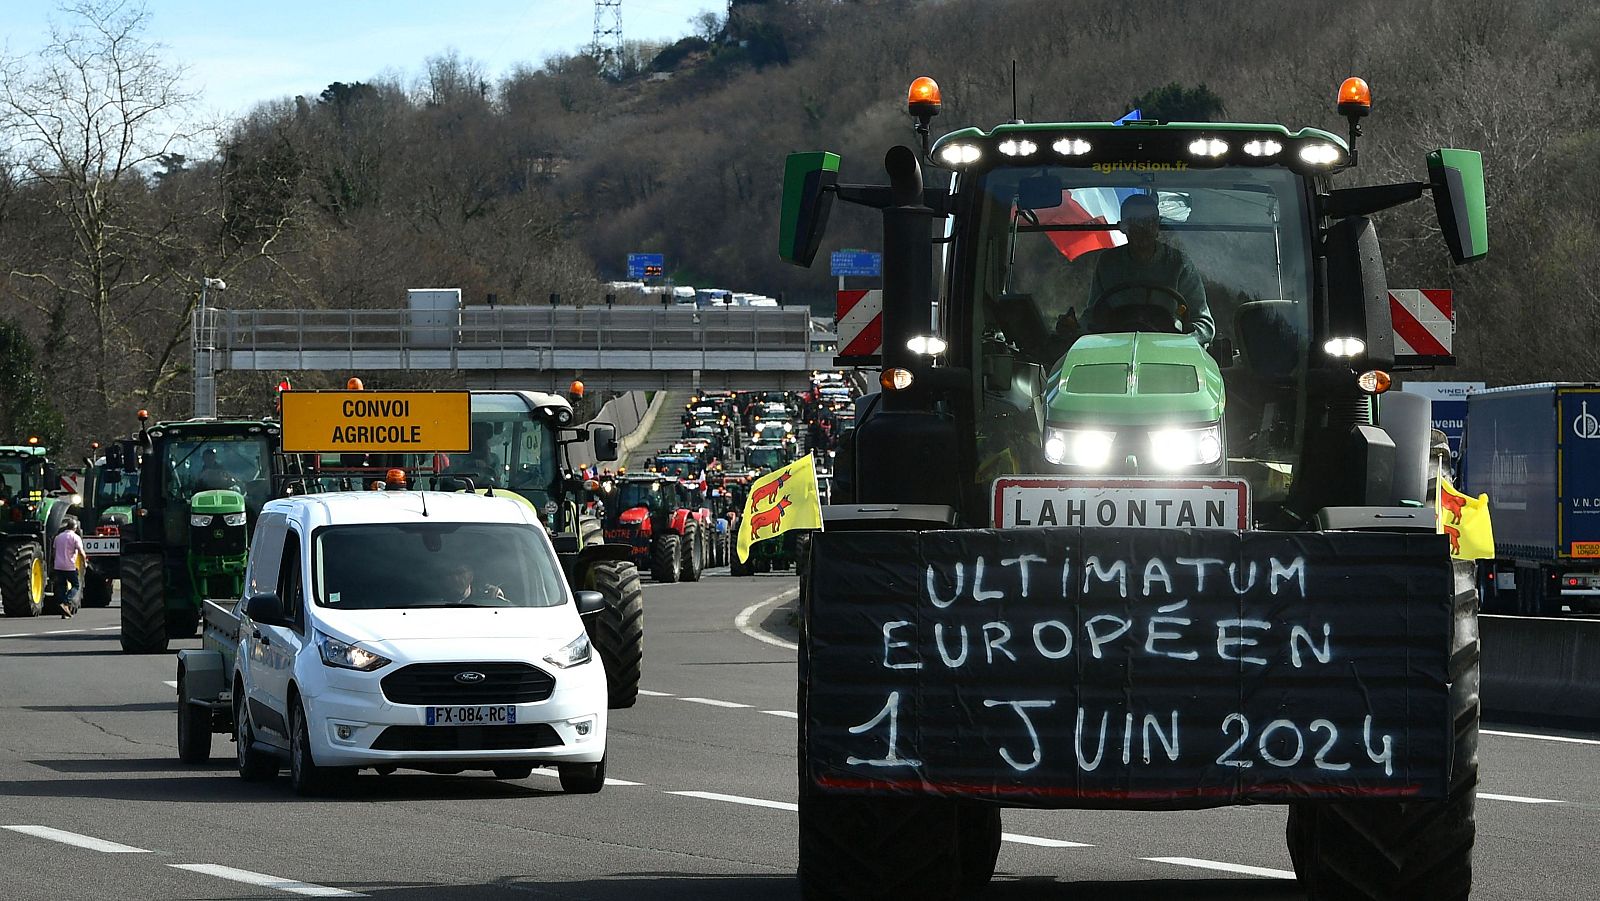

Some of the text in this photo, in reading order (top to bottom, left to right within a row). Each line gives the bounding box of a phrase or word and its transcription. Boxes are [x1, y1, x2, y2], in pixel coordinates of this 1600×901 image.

[1092, 160, 1189, 174] agrivision.fr
[342, 399, 409, 418] CONVOI
[331, 425, 421, 444] AGRICOLE
[1014, 499, 1225, 527] LAHONTAN
[86, 542, 99, 550] DO
[882, 599, 1332, 670] EUROPÉEN
[435, 706, 506, 722] FX-084-RC
[846, 691, 1394, 776] 1 JUIN 2024
